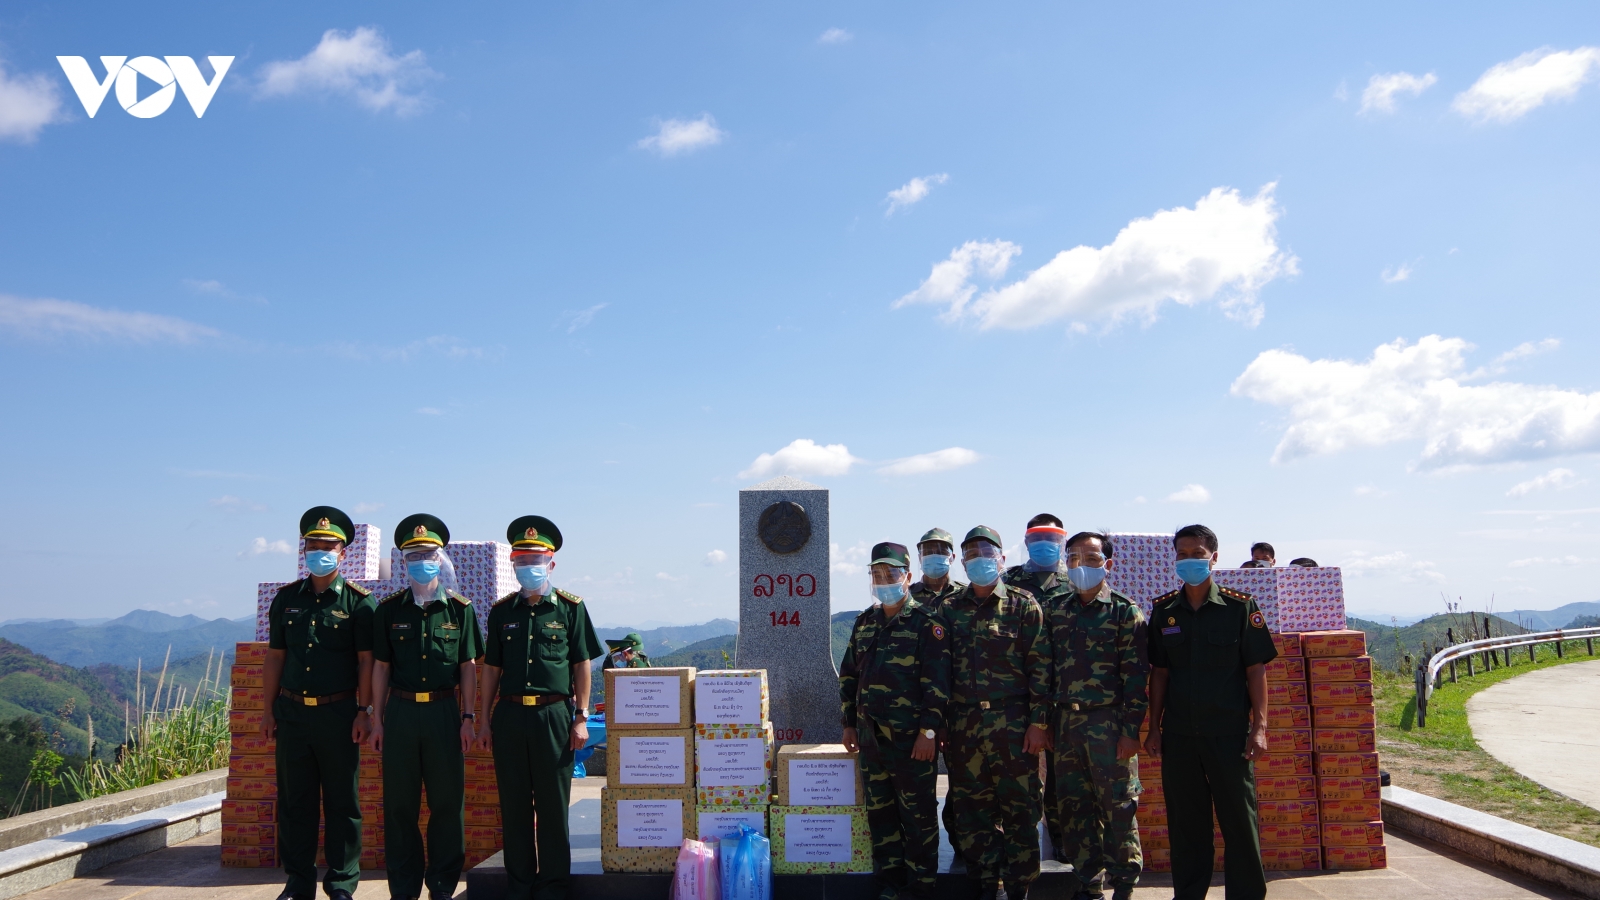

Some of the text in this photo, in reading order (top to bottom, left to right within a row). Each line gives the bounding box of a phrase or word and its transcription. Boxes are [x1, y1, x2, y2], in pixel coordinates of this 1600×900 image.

[753, 573, 816, 597] ລາວ
[770, 611, 801, 627] 144
[774, 728, 804, 741] 009
